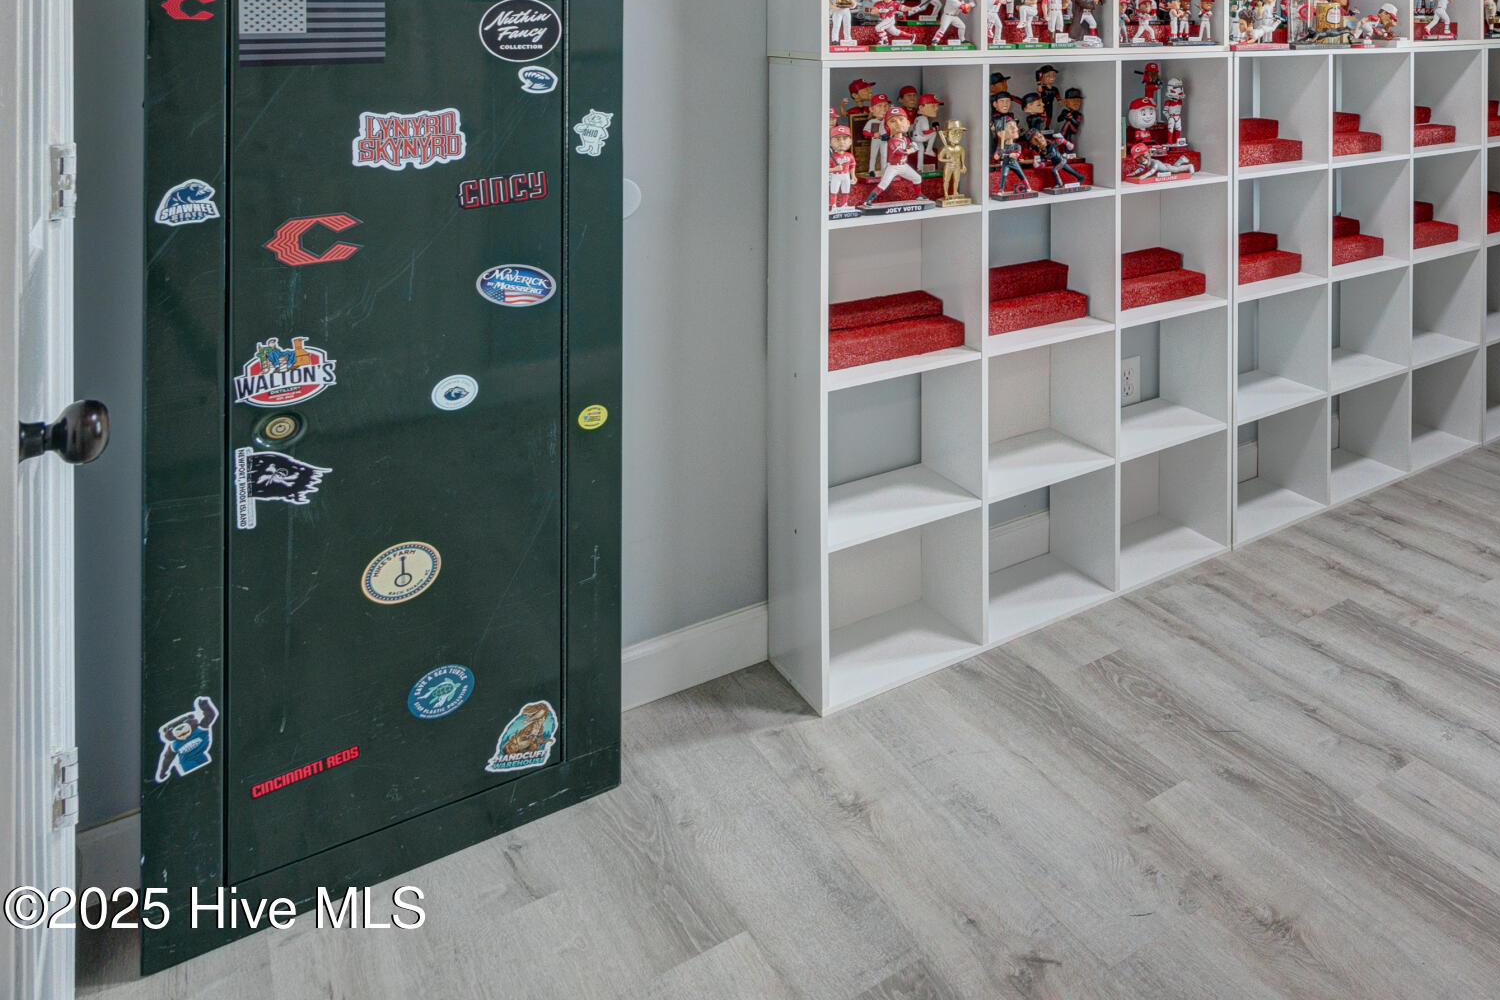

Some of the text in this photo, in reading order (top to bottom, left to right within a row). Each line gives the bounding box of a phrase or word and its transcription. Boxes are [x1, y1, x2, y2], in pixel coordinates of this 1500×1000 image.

[496, 24, 548, 43] Fancy
[499, 43, 544, 51] COLLECTION
[365, 110, 457, 140] LYNYRD
[358, 133, 463, 168] SKYNYRD
[457, 170, 549, 210] CINCY
[160, 202, 217, 221] SHAWNEE
[885, 205, 922, 215] JOEY VOTTO
[236, 362, 336, 399] WALTON'S
[491, 757, 546, 770] WAREHOUSE
[495, 750, 549, 764] HANDCUFF
[250, 745, 361, 799] CINCINNATI REDS
